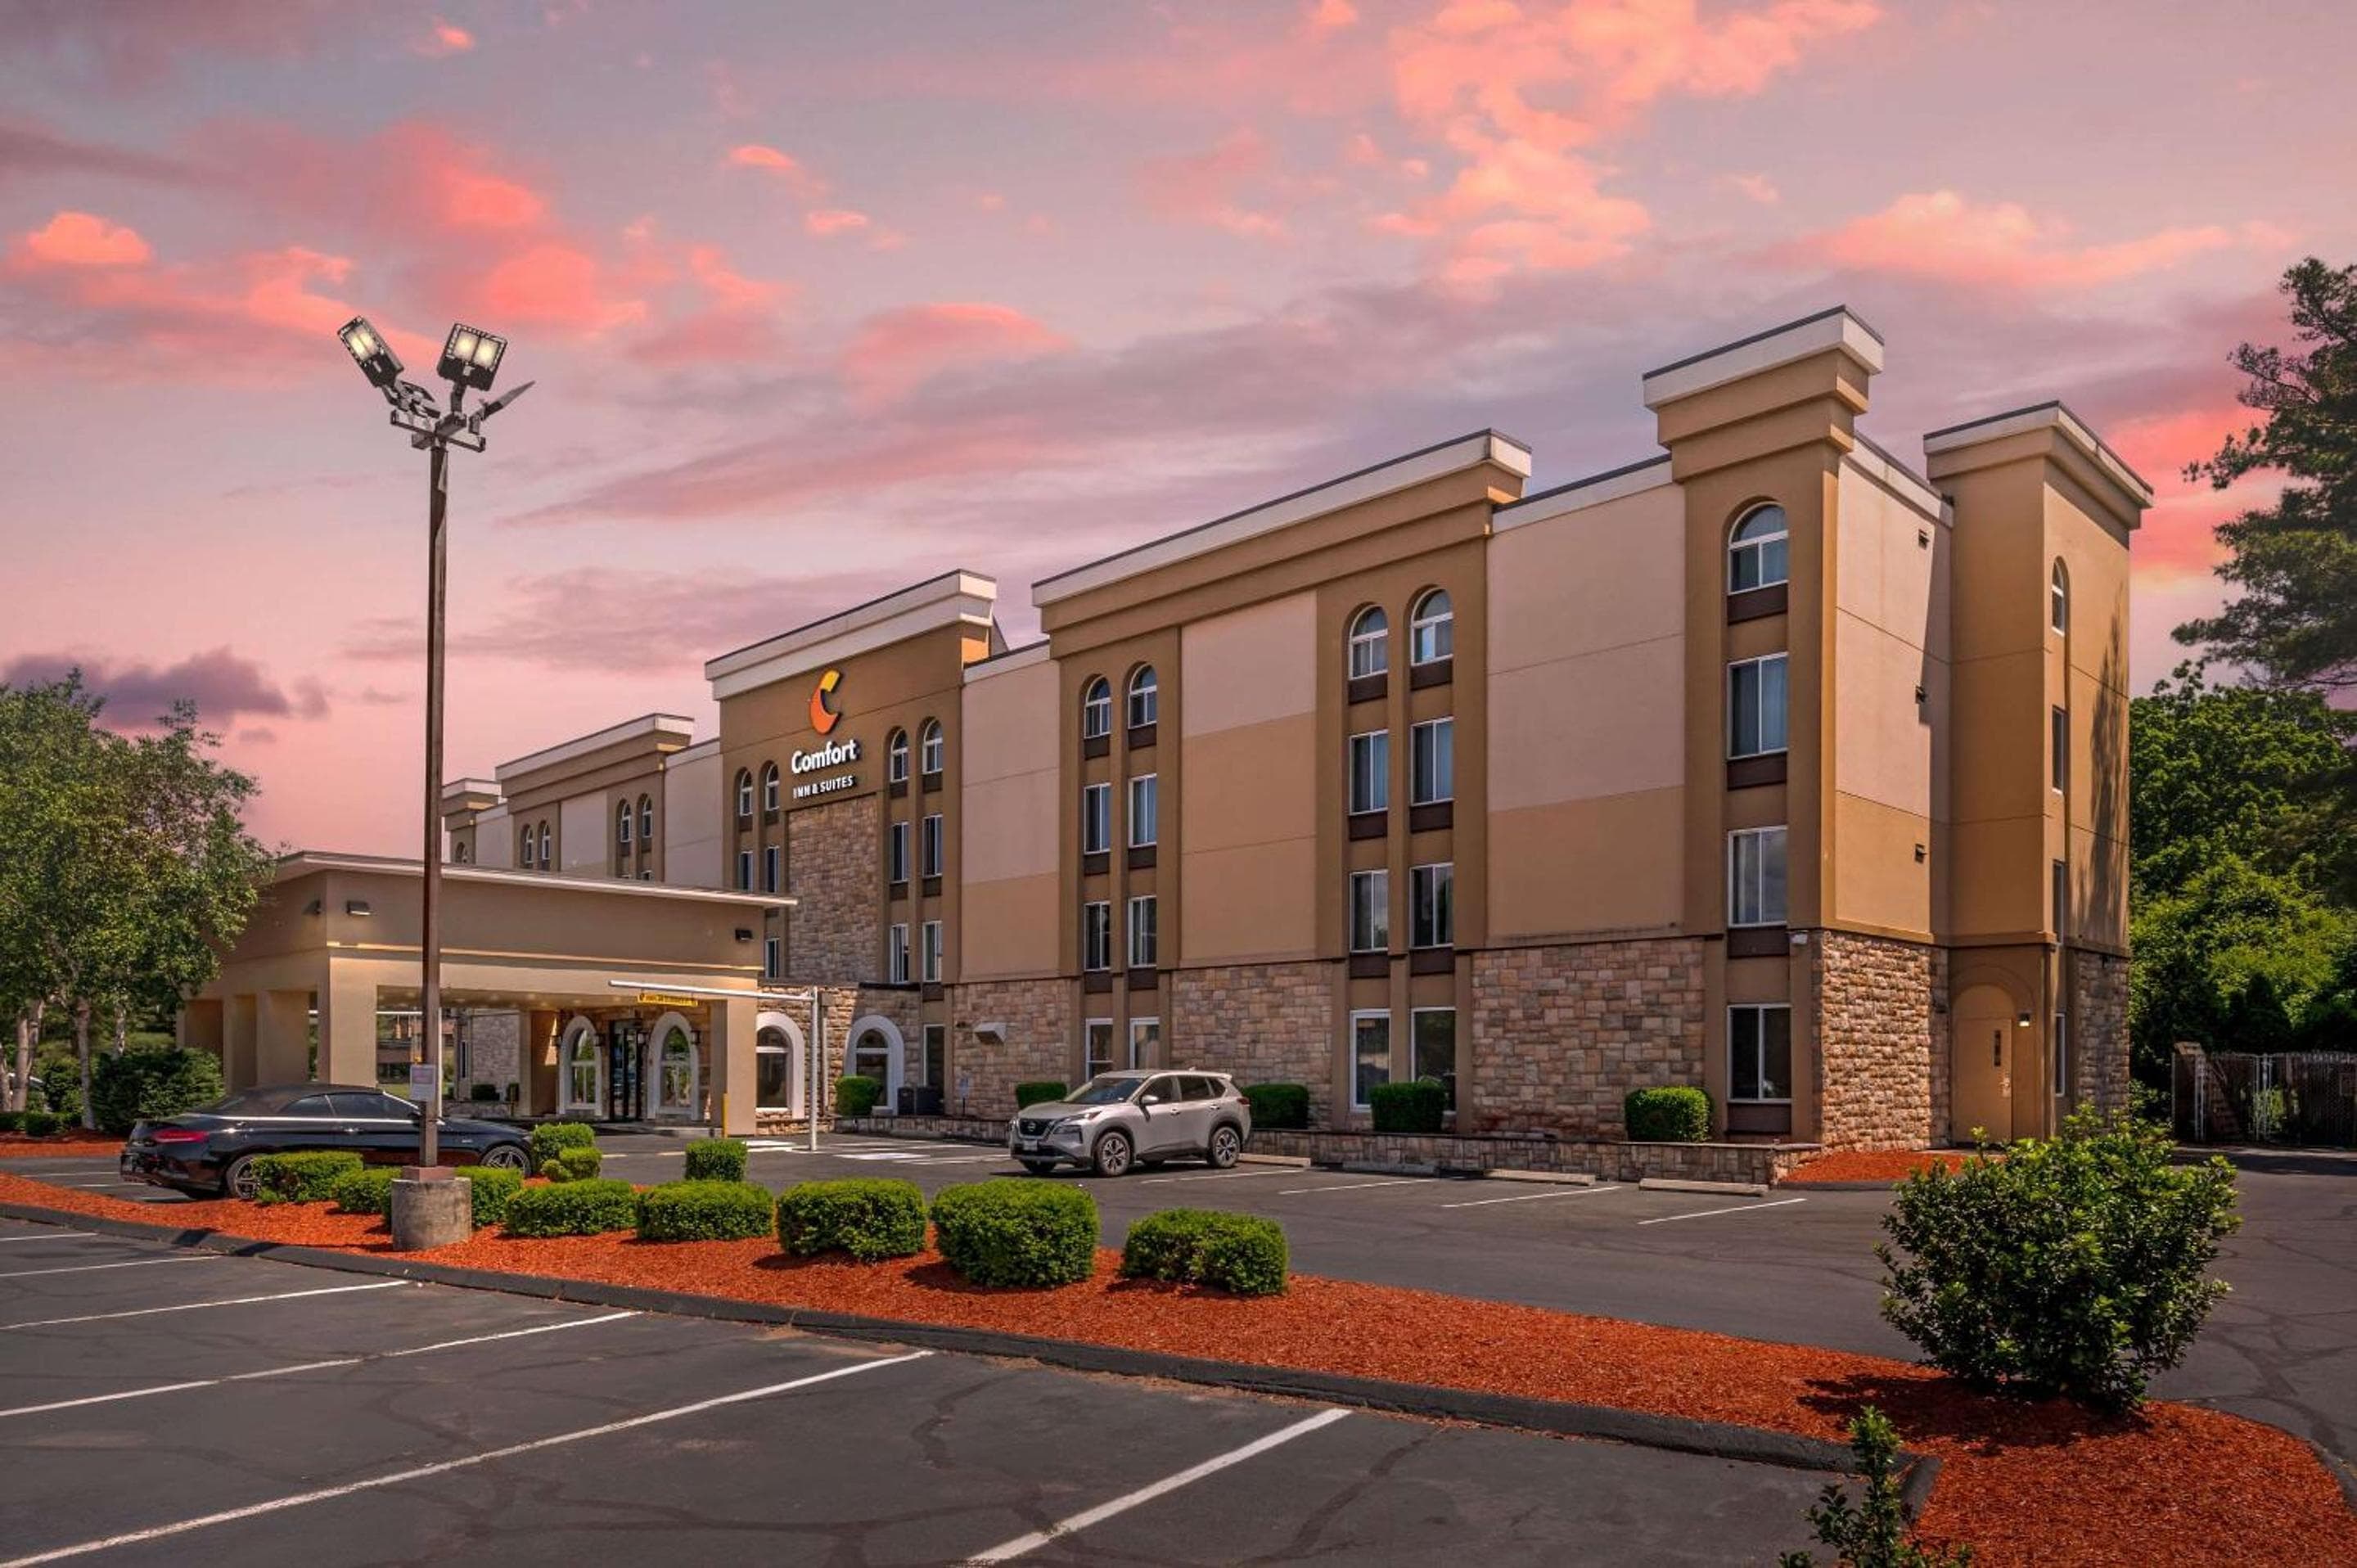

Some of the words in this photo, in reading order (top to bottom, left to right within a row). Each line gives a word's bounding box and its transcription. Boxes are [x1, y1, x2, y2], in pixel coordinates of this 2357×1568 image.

[791, 739, 856, 773] Comfort
[793, 785, 810, 799] INN
[820, 775, 853, 793] SUITES
